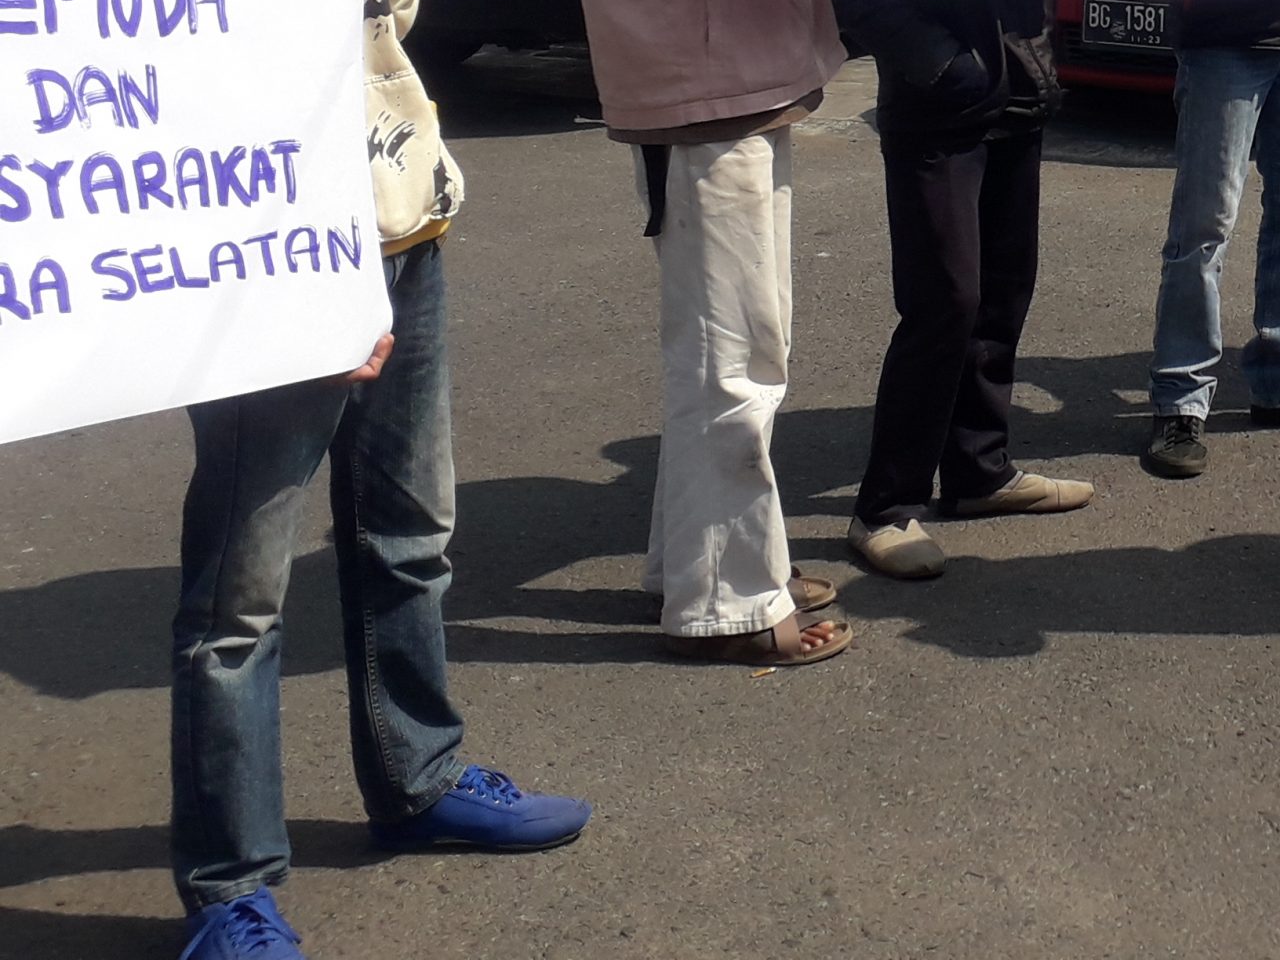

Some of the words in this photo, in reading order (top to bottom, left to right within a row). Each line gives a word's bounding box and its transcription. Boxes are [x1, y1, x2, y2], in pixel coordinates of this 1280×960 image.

[1089, 3, 1110, 28] BG
[1126, 5, 1164, 32] 1581
[26, 64, 160, 134] DAN
[0, 139, 301, 222] SYARAKAT
[91, 215, 362, 302] SELATAN
